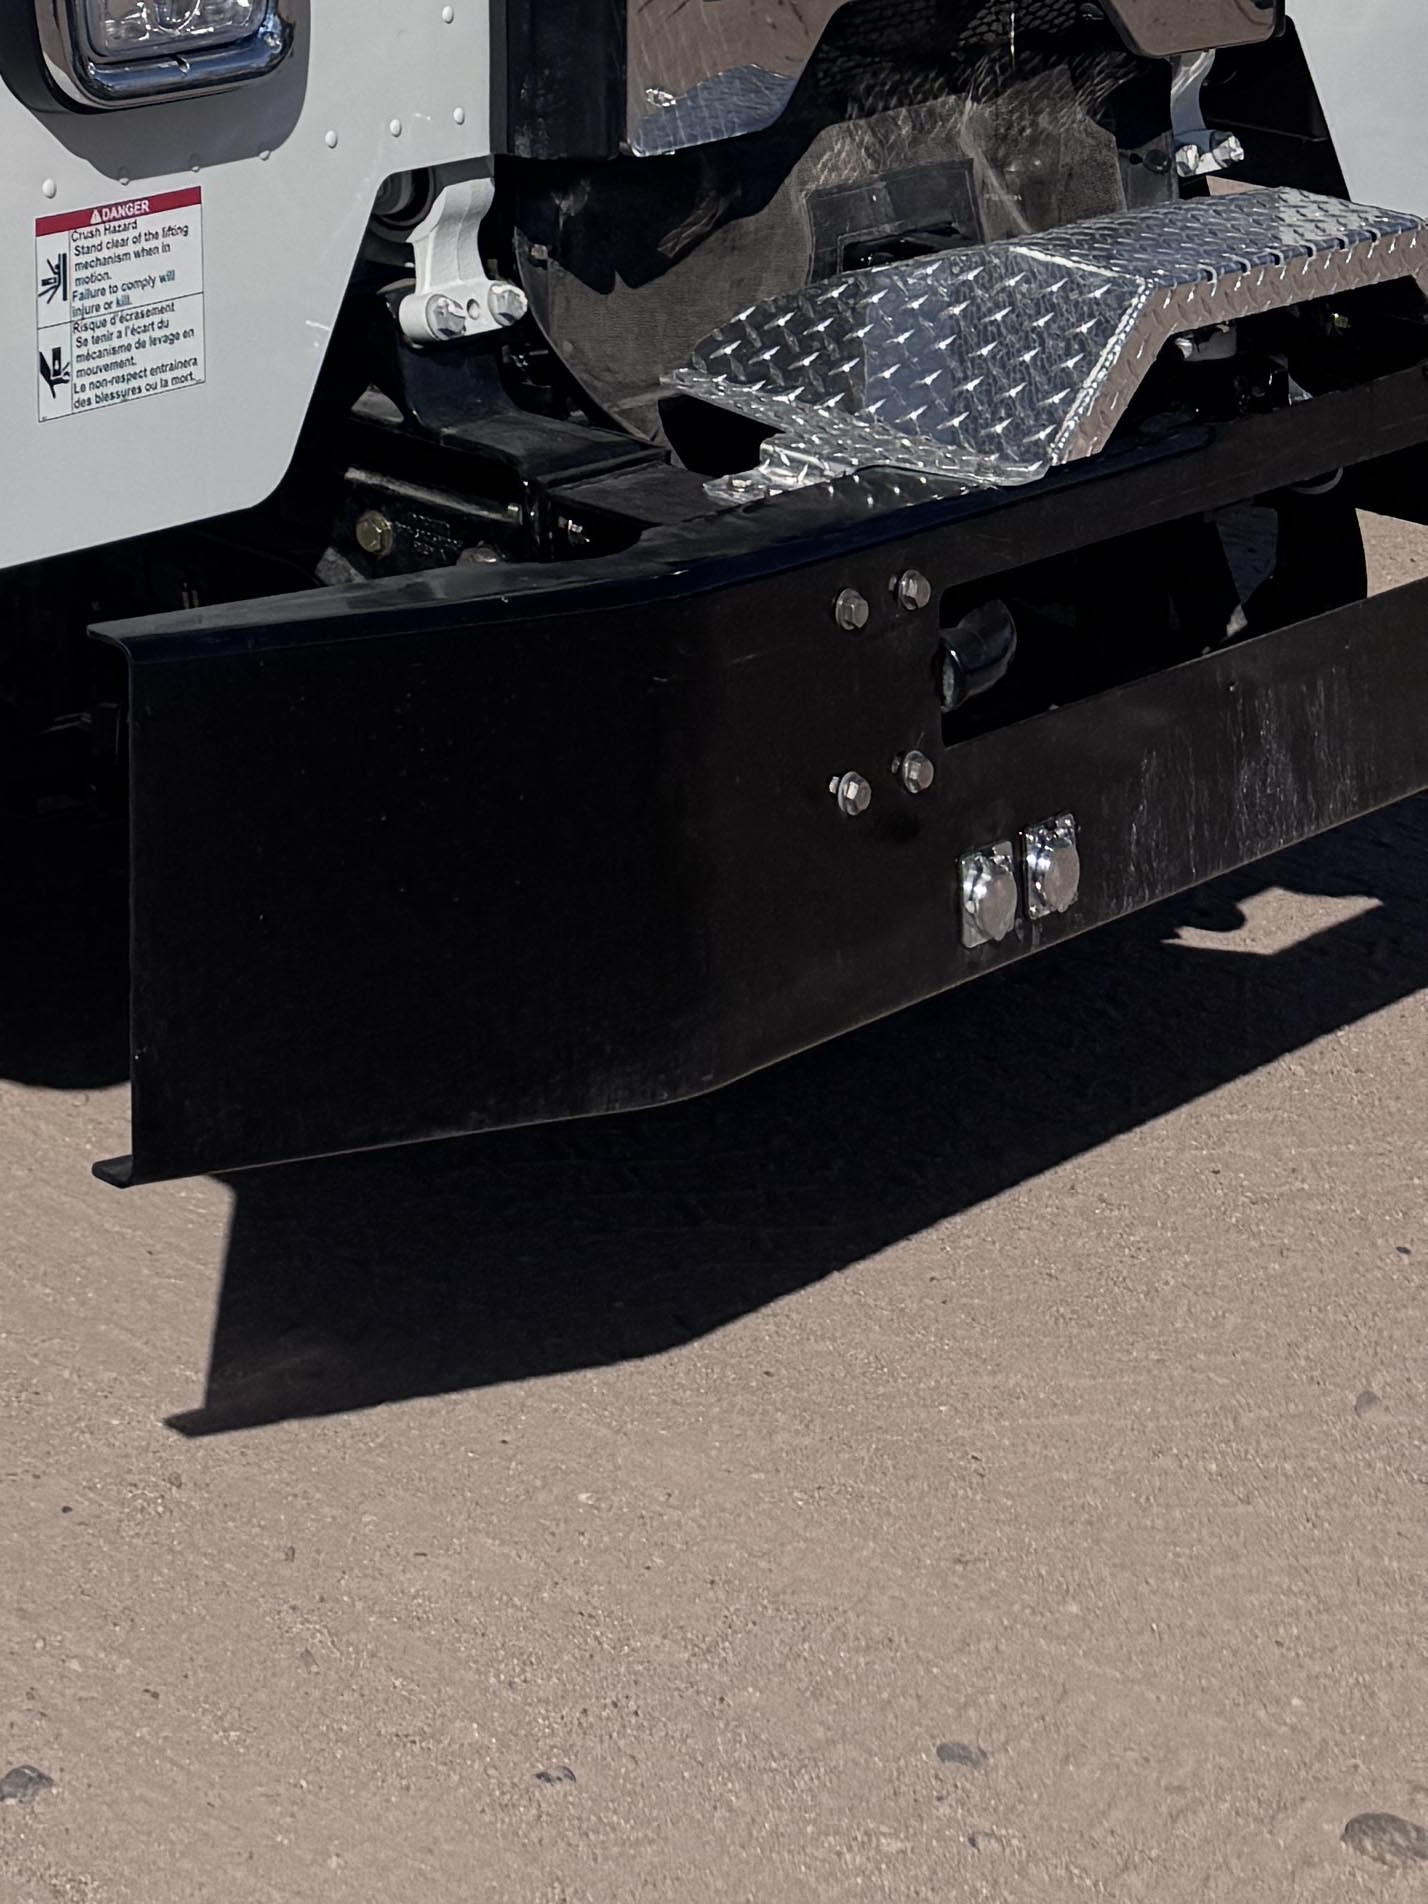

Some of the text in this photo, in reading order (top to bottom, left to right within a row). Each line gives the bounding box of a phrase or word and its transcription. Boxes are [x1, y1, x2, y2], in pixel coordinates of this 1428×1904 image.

[102, 200, 149, 221] DANGER
[71, 220, 138, 242] Crush Hazard
[75, 225, 189, 256] Stand clear of the lifting
[75, 242, 170, 272] mechanism when in
[72, 270, 175, 302] Failure to comply will
[75, 271, 112, 287] motion.
[72, 295, 132, 320] injure or kill.
[73, 303, 175, 334] Risque d'écrasement
[76, 337, 88, 349] Se
[92, 331, 113, 344] tenir
[125, 323, 155, 337] l'écart
[157, 319, 169, 329] du
[76, 328, 194, 363] mécanisme de levage en
[74, 383, 86, 394] Le
[89, 369, 147, 392] non-respect
[76, 357, 136, 378] mouvement.
[74, 372, 195, 409] des blessures ou la mort.
